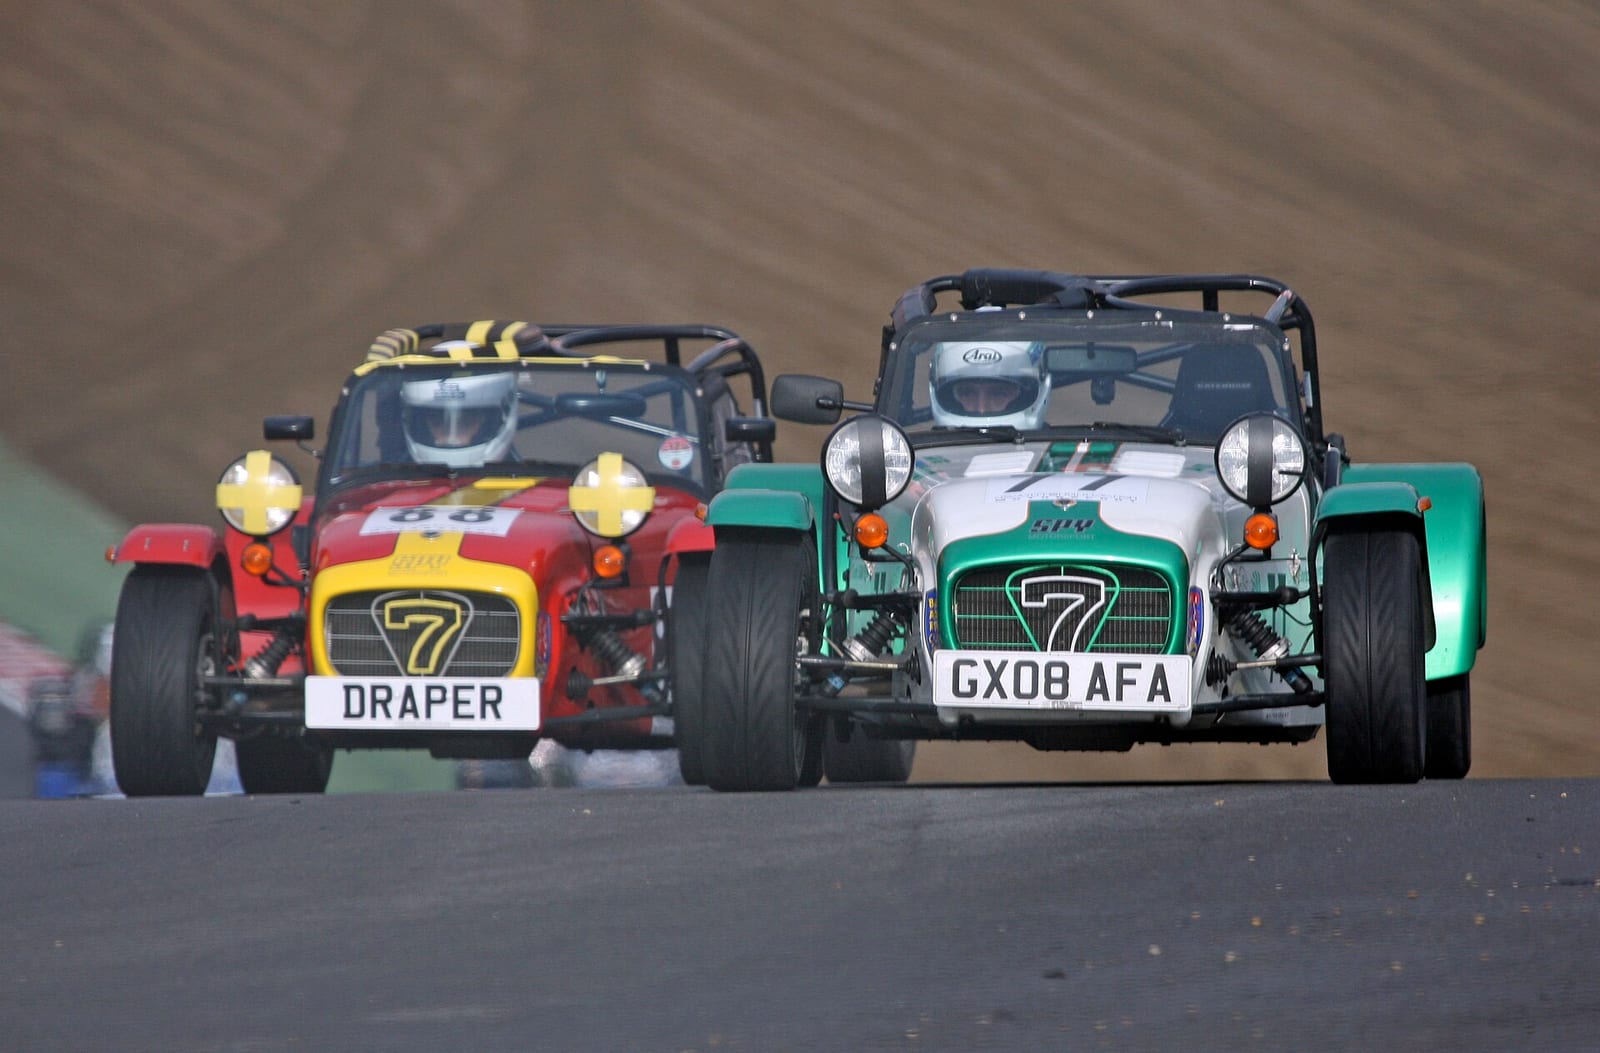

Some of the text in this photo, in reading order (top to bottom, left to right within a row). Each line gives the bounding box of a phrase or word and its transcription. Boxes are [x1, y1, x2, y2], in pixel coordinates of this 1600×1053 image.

[966, 349, 998, 361] Arai
[1030, 518, 1096, 533] SPY
[1021, 575, 1105, 653] 7
[384, 598, 461, 674] 7
[952, 659, 1172, 703] GX08 AFA
[343, 684, 503, 720] DRAPER
